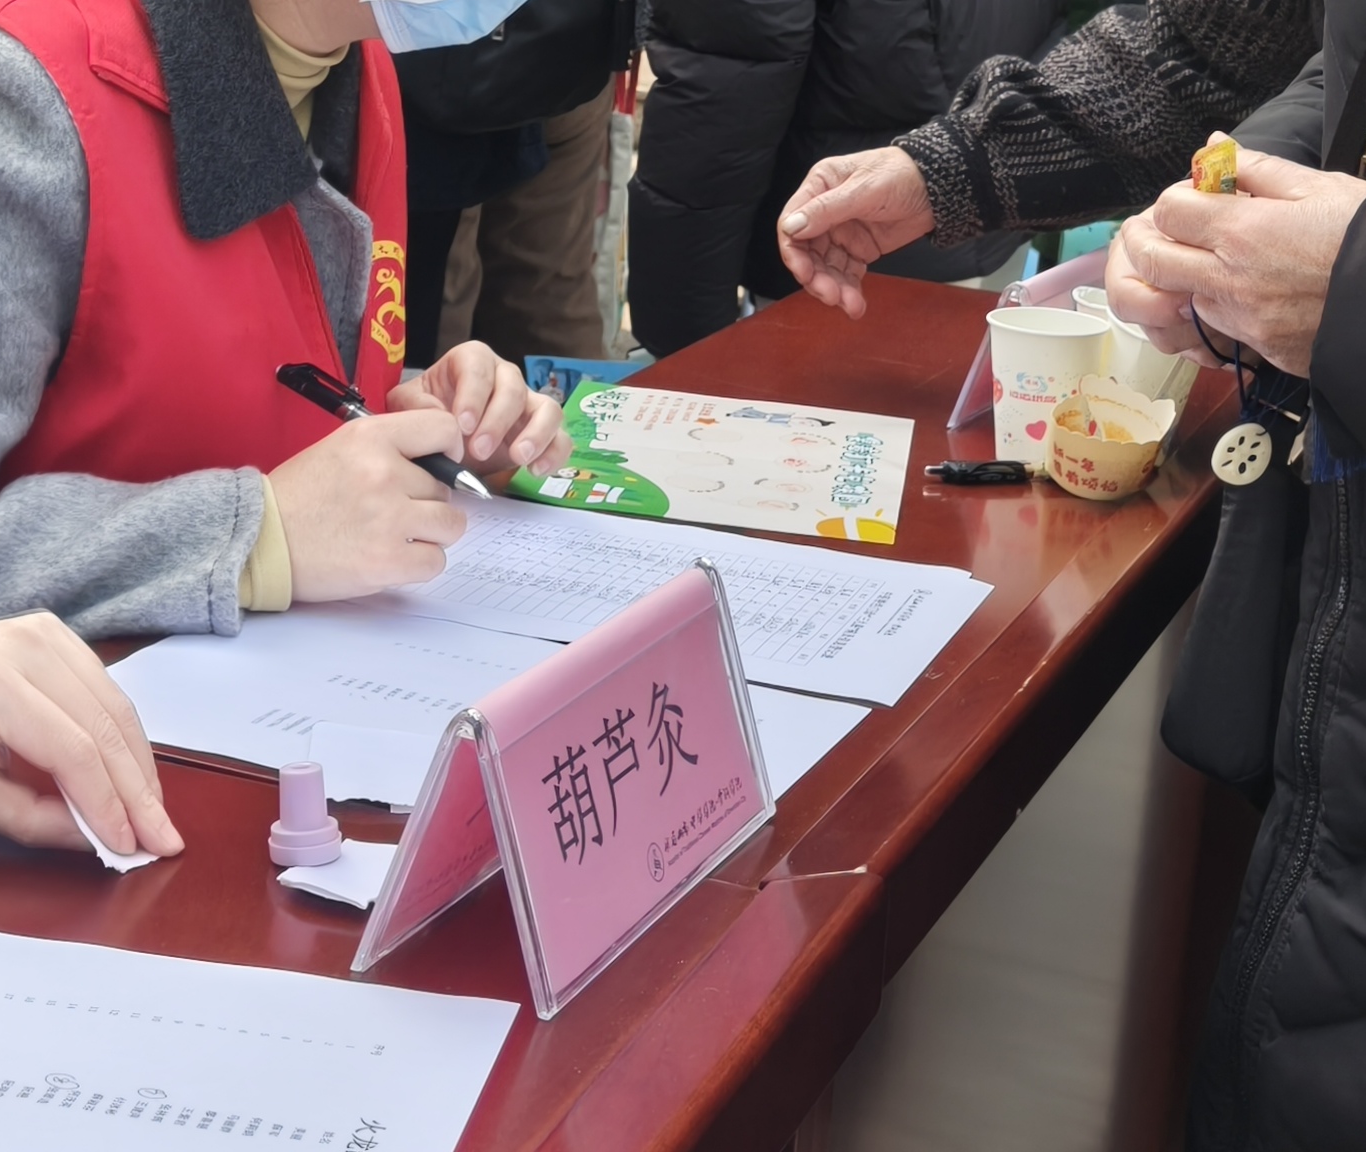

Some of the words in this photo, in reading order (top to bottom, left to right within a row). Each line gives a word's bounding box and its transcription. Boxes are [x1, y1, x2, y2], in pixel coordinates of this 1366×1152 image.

[541, 681, 699, 866] 葫芦灸
[345, 1117, 386, 1152] 火龙
